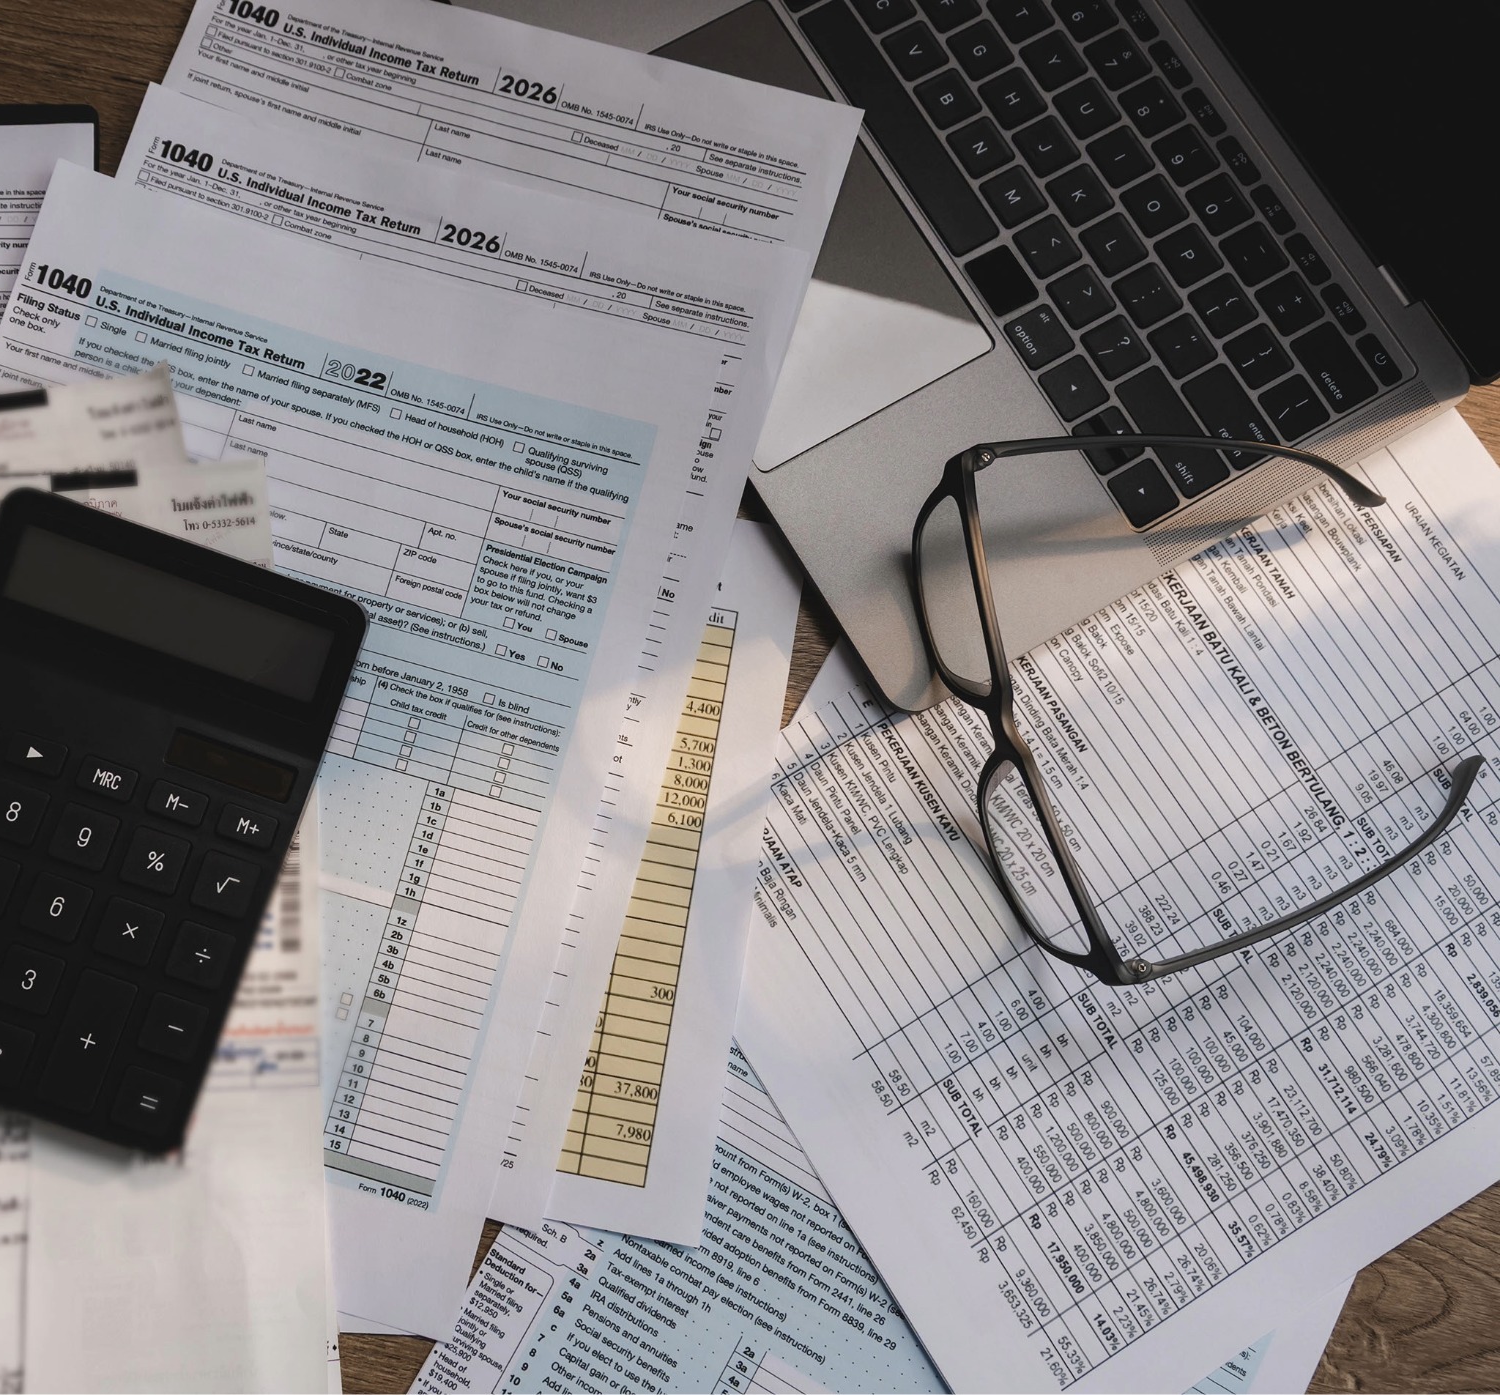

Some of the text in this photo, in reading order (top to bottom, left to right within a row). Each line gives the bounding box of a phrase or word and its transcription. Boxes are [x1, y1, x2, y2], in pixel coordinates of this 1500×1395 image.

[282, 21, 480, 86] U.S. Individual Income Tax Return
[497, 74, 558, 105] 2026
[560, 99, 634, 126] OMB No. 1545-0074
[433, 122, 471, 140] Last name
[159, 139, 214, 173] 1040
[216, 166, 421, 236] U.S. Individual Income Tax Return
[671, 185, 780, 221] Your social security number
[439, 223, 501, 254] 2026
[36, 263, 93, 300] 1040
[15, 291, 81, 321] Filing Status
[94, 294, 306, 370] U.S. Individual Income Tax Return
[99, 320, 128, 337] Single
[1014, 324, 1037, 355] option
[149, 336, 232, 370] Married filing jointly
[323, 358, 387, 391] 2022
[1320, 371, 1343, 400] delete
[403, 412, 505, 449] Head of household (HOH)
[1248, 422, 1266, 442] enter
[1174, 461, 1194, 485] shift
[501, 489, 612, 526] Your social security number
[1403, 500, 1467, 581] URAIAN KEGIATAN
[401, 547, 438, 565] ZIP code
[484, 543, 608, 585] Presidential Election Campaign
[516, 621, 533, 633] You
[557, 633, 589, 649] Spouse
[508, 648, 526, 662] Yes
[549, 660, 564, 672] No
[389, 697, 448, 721] Child tax credit
[685, 700, 721, 716] 4,400
[1202, 630, 1346, 831] BATU KALI & BETON BERTULANG,
[91, 767, 122, 791] MRC
[434, 786, 446, 798] 1a
[876, 721, 961, 842] PEKERJAAN KUSEN KAYU
[5, 800, 22, 822] 8
[664, 791, 706, 809] 12,000
[775, 780, 808, 826] Kaca Mati
[76, 826, 92, 848] 9
[235, 816, 260, 835] M+
[48, 895, 66, 917] 6
[389, 929, 404, 941] 2b
[367, 1018, 375, 1028] 7
[1076, 991, 1118, 1051] SUB TOTAL
[613, 1080, 659, 1101] 37,800
[1317, 1062, 1358, 1115] 31,712,114
[329, 1138, 342, 1150] 15
[616, 1123, 652, 1142] 7,980
[1181, 1151, 1220, 1203] 45,498,930
[357, 1182, 429, 1211] Form 1040 (2022)
[488, 1247, 527, 1276] Standard
[1046, 1240, 1085, 1294] 17,950,000
[468, 1296, 499, 1319] $12,950
[589, 1288, 660, 1338] IRA distributions
[597, 1275, 677, 1330] Qualified dividends
[997, 1279, 1034, 1330] 3,653,325
[1092, 1312, 1121, 1351] 14.03%
